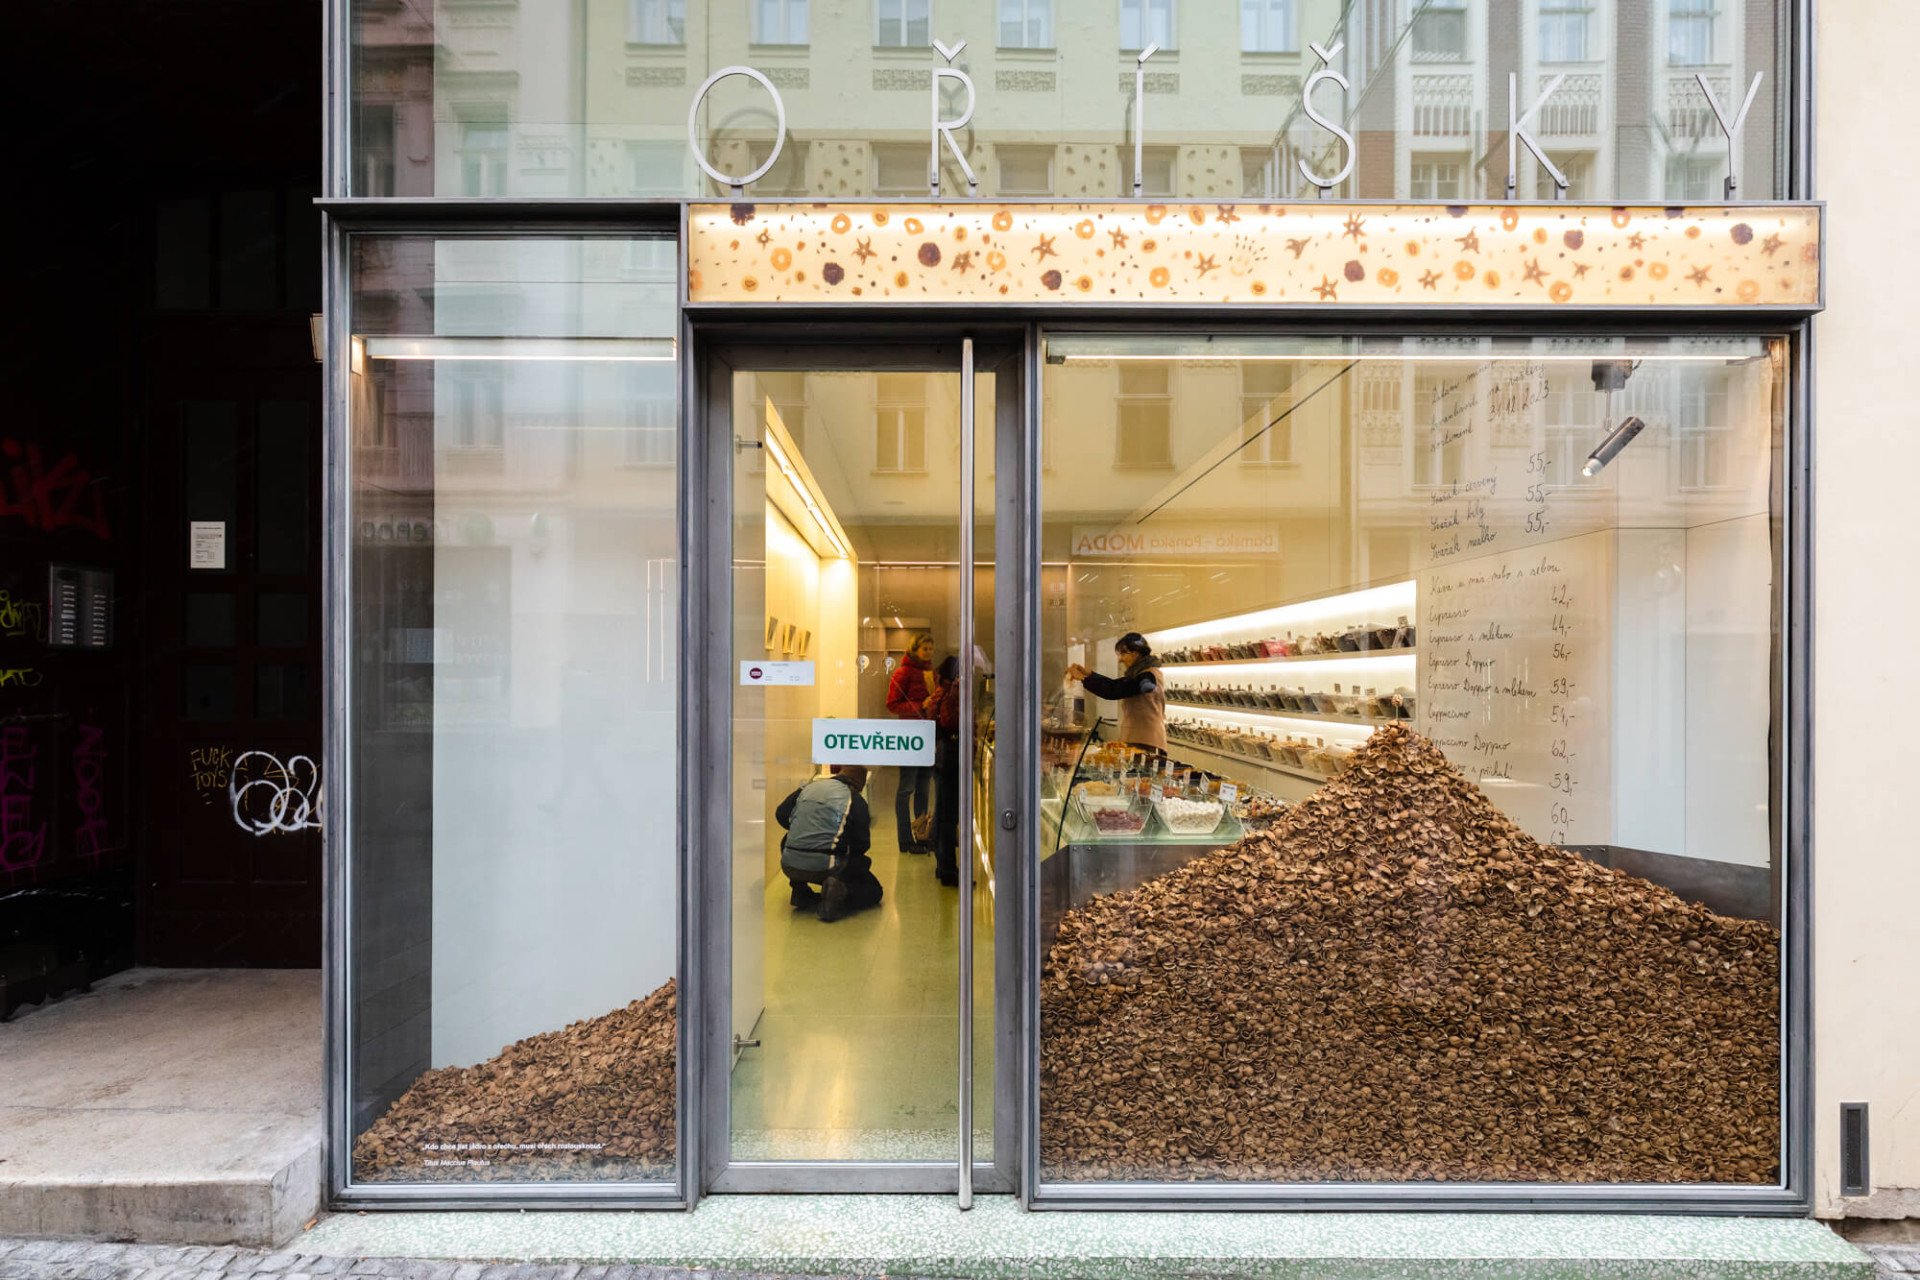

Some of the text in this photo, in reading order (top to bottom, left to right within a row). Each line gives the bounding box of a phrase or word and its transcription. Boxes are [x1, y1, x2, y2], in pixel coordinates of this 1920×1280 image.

[687, 39, 1764, 187] OŘÍŠKY
[824, 731, 924, 751] OTEVŘENO
[190, 746, 231, 772] FUCK
[189, 768, 228, 791] TOYS
